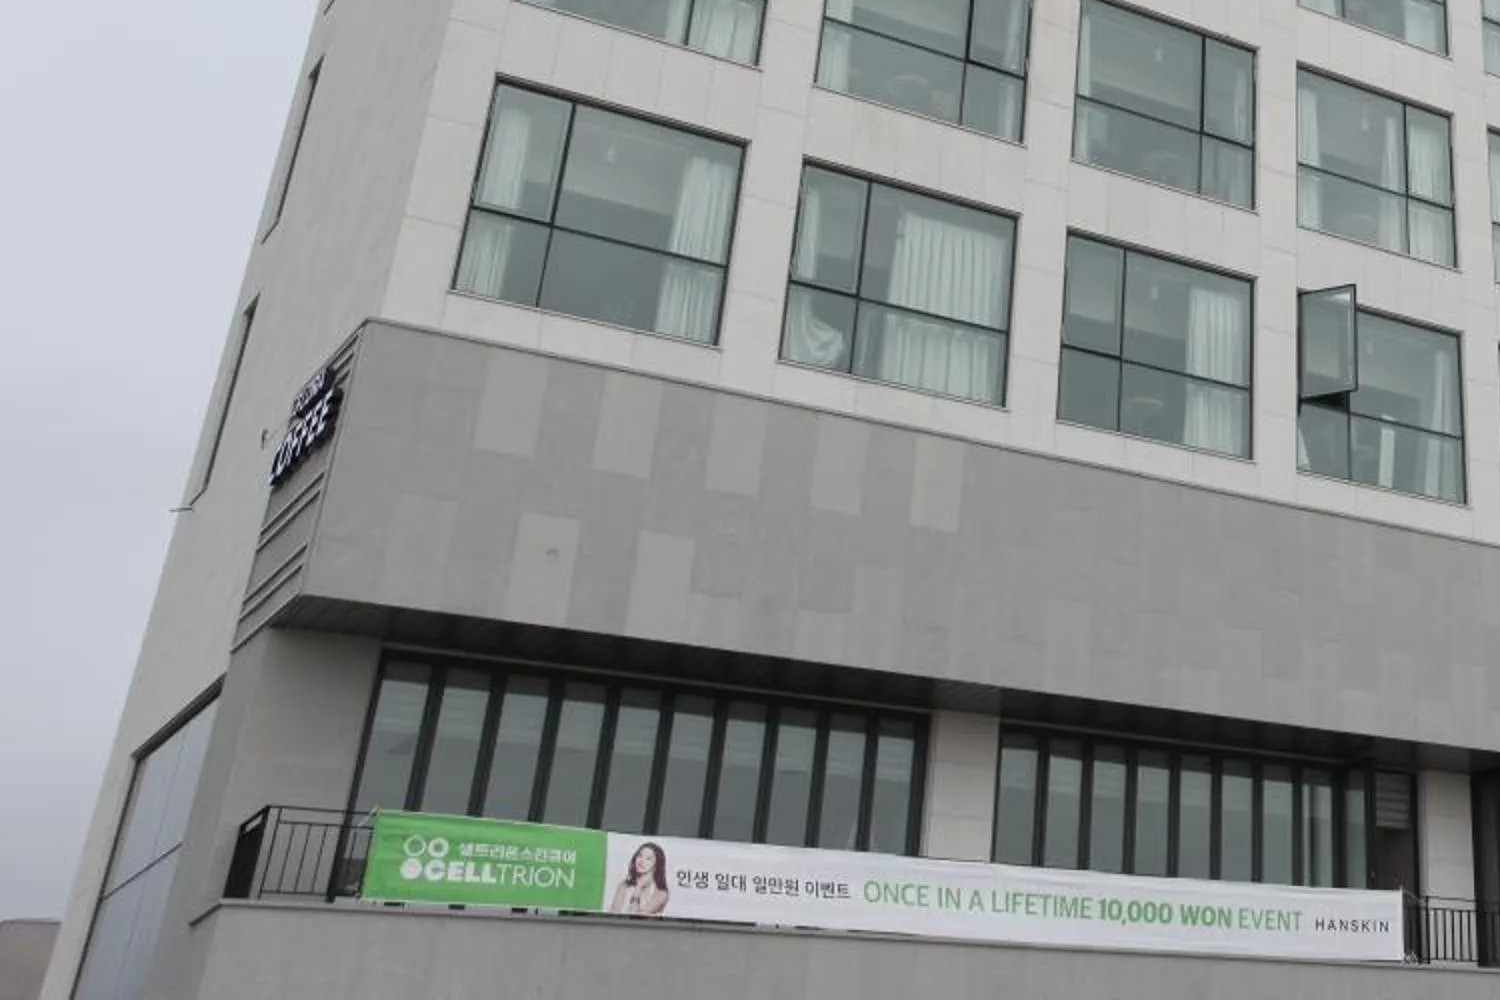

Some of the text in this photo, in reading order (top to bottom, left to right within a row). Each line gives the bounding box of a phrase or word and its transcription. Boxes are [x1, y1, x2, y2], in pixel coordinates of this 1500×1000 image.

[423, 859, 575, 889] CELLTRION
[676, 869, 852, 899] 인생 일대 일만원 이벤트
[863, 880, 1303, 932] ONCE IN A LIFETIME 10,000 WON EVENT
[1314, 916, 1390, 933] HANSKIN
